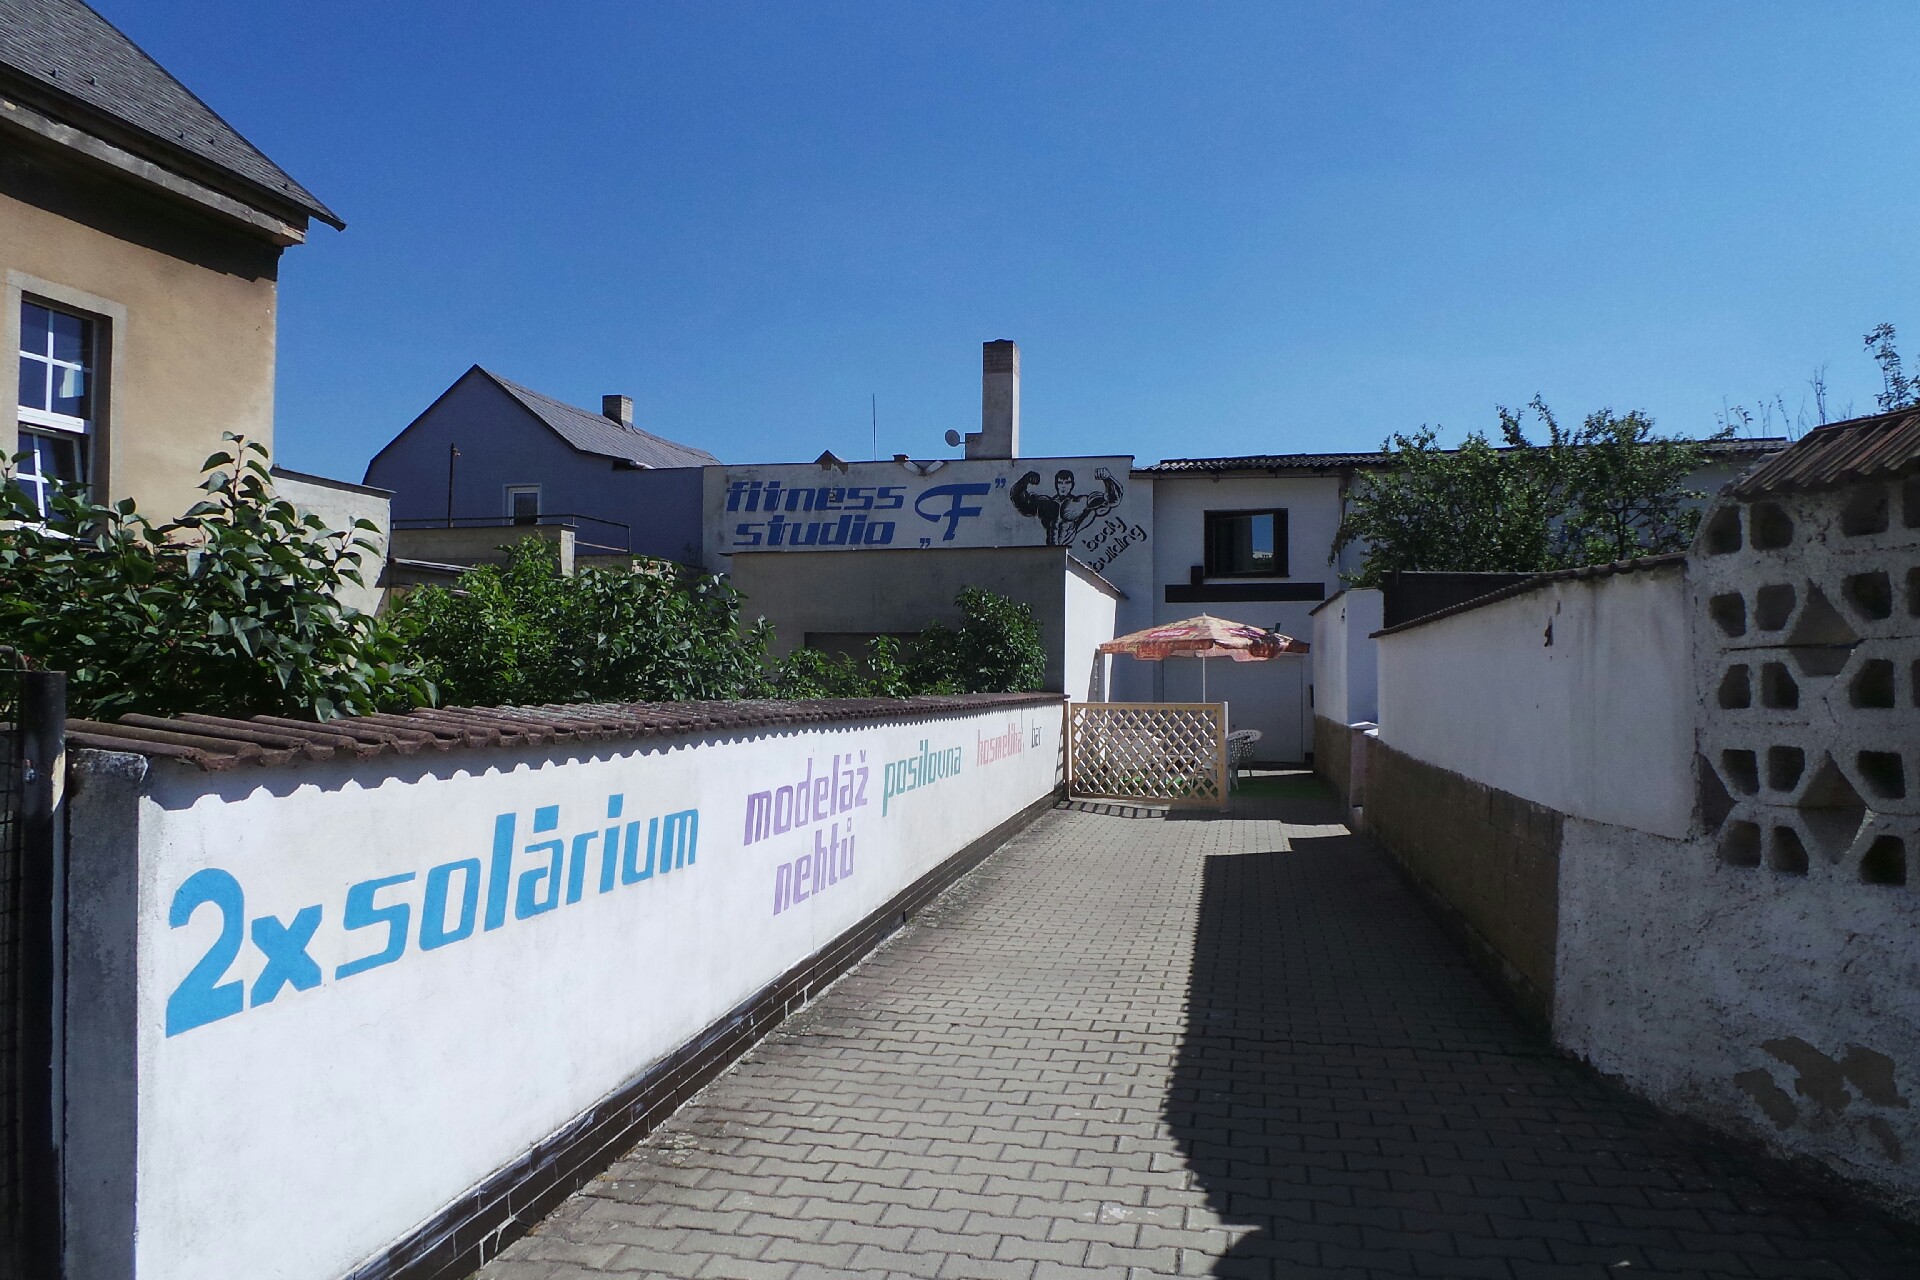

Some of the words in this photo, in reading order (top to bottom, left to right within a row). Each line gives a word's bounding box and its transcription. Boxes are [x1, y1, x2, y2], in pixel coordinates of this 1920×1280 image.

[726, 481, 907, 512] fitness
[733, 515, 895, 546] studio
[1082, 516, 1127, 552] body
[1088, 525, 1147, 573] building
[1031, 719, 1042, 748] bar
[743, 749, 869, 846] modeláž
[882, 739, 962, 817] posilovna
[773, 817, 855, 916] nehtů
[165, 867, 323, 1038] 2x
[334, 793, 699, 981] solárium
